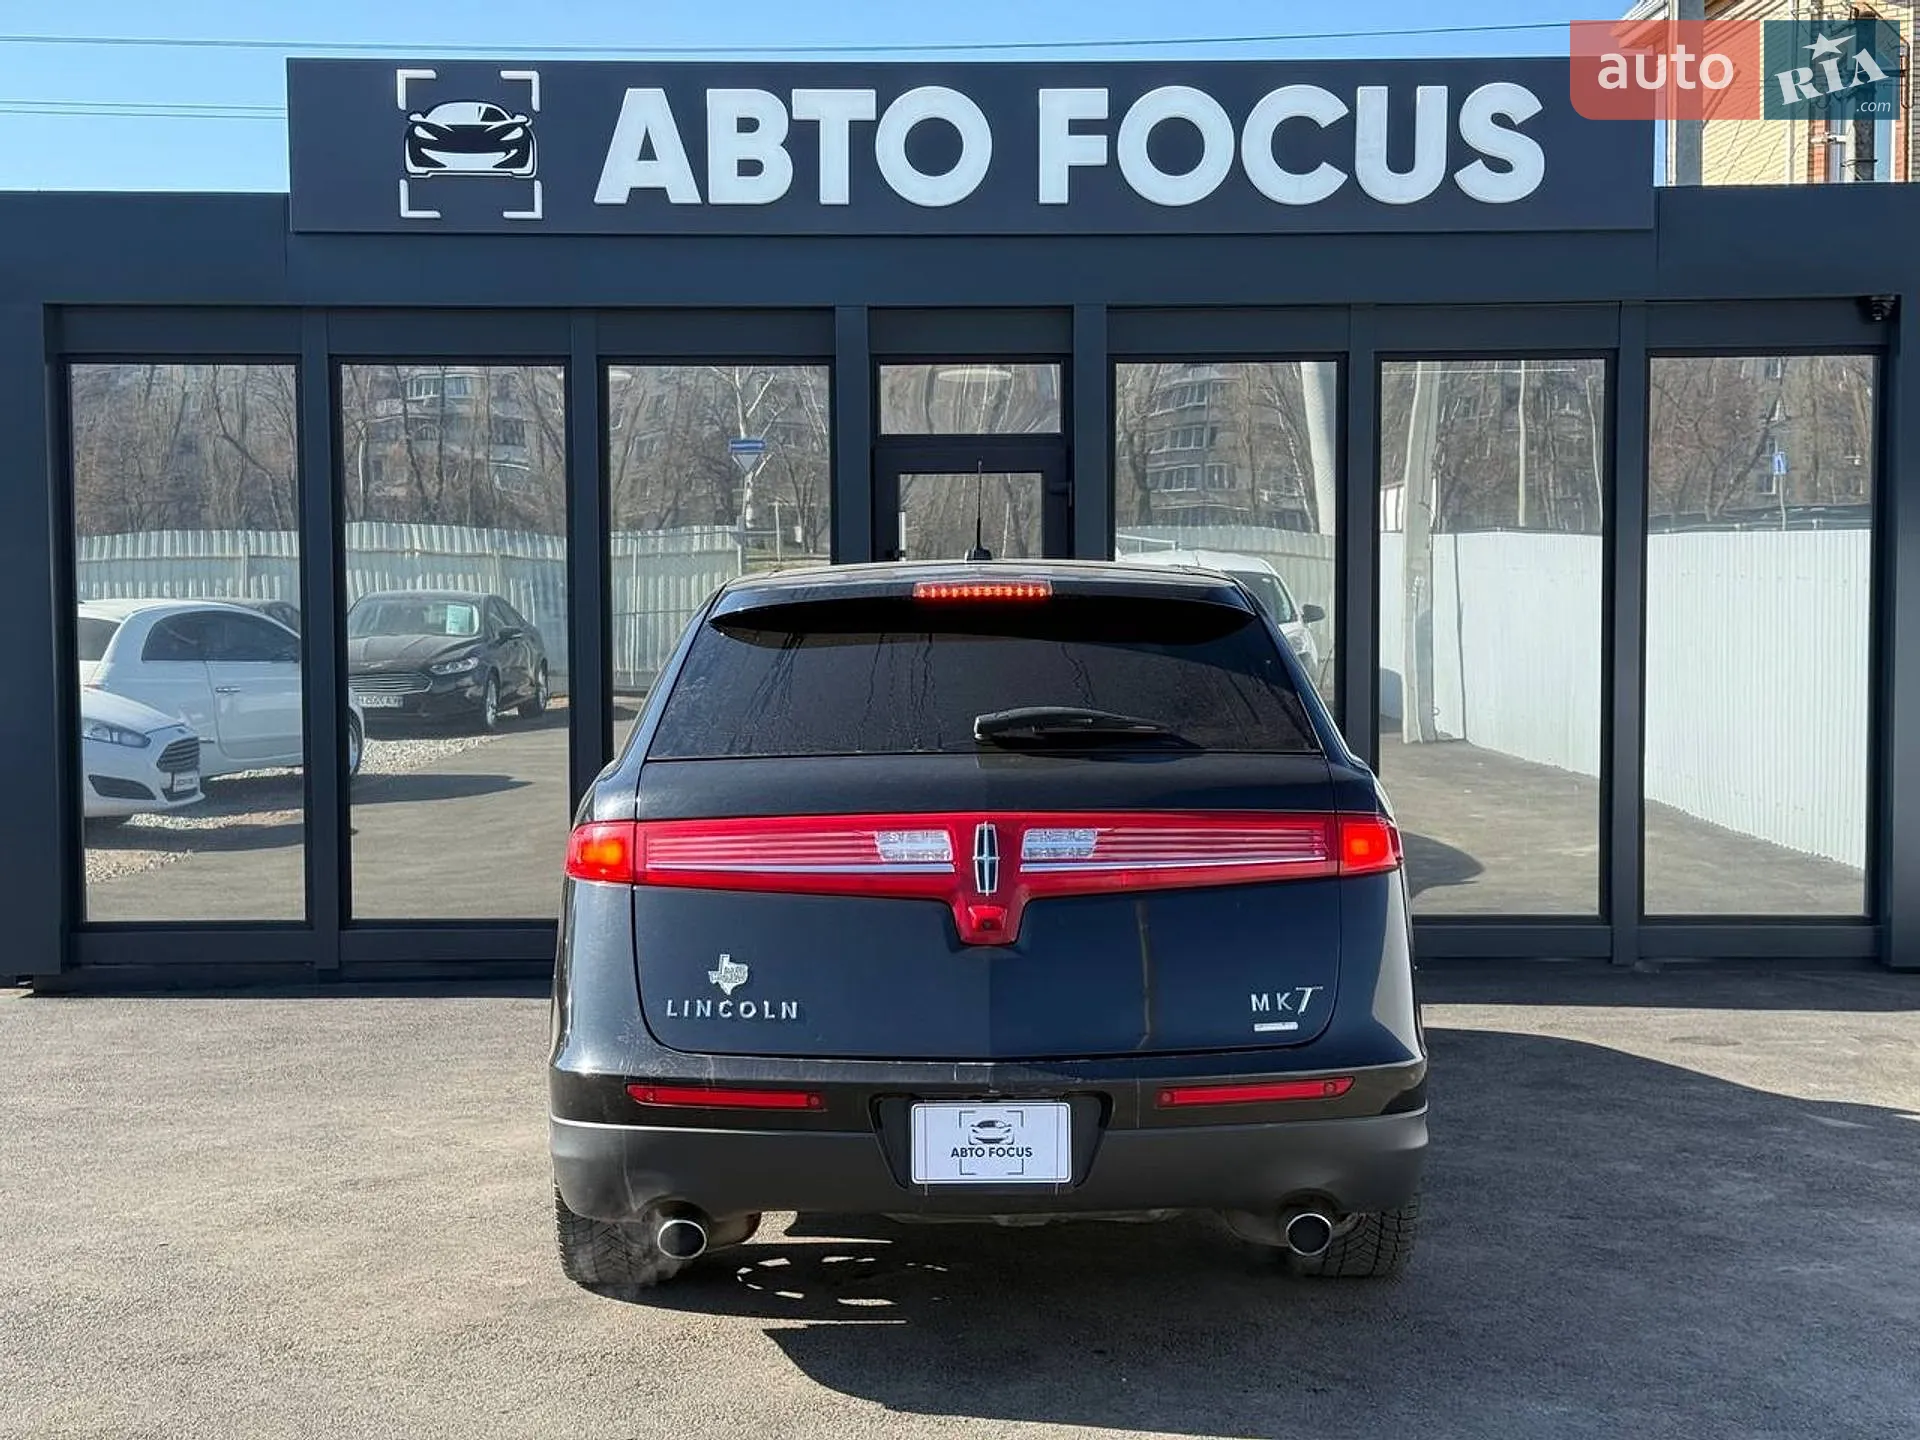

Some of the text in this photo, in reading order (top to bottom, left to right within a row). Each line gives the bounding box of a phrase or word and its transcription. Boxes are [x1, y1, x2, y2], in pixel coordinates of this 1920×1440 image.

[594, 82, 1546, 207] АВТО FOCUS
[666, 999, 799, 1020] LINCOLN
[1250, 985, 1324, 1015] MKT
[988, 1147, 1033, 1158] FOCUS
